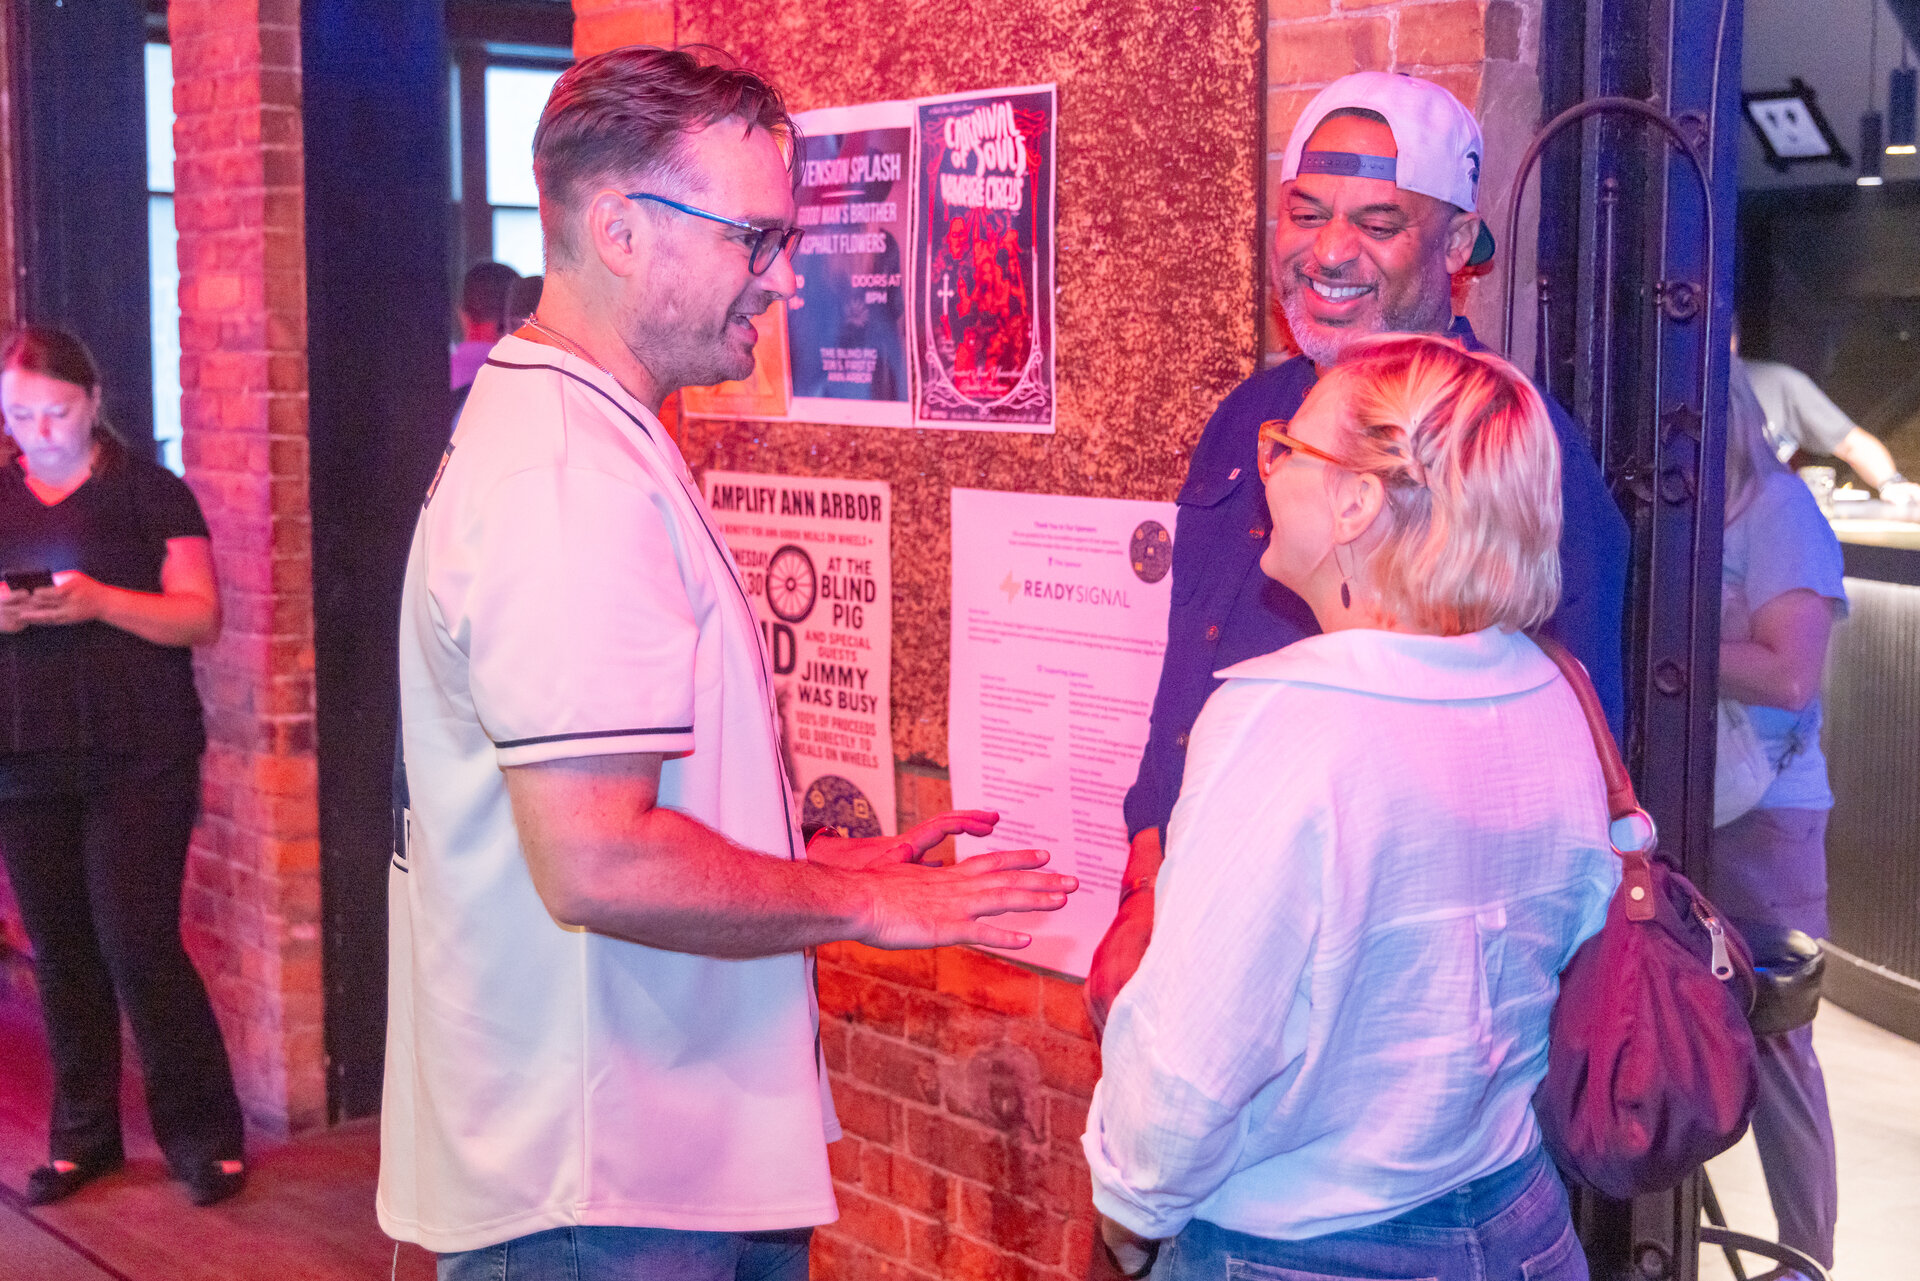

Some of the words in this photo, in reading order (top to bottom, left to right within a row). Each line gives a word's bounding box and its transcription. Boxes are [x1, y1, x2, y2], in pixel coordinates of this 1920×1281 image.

[944, 100, 1020, 150] CARNIVAL
[851, 153, 901, 184] SPLASH
[976, 135, 1027, 179] SOULS
[941, 172, 985, 209] VAMPIRE
[986, 176, 1024, 211] CIRCUS
[850, 201, 897, 223] BROTHER
[841, 232, 887, 254] FLOWERS
[851, 273, 887, 288] DOORS
[888, 273, 902, 287] AT
[711, 484, 777, 514] AMPLIFY
[780, 488, 816, 518] ANN
[820, 491, 882, 523] ARBOR
[730, 548, 768, 567] NESDAY
[827, 556, 841, 572] AT
[847, 558, 871, 575] THE
[821, 574, 876, 603] BLIND
[832, 603, 863, 629] PIG
[804, 630, 826, 644] AND
[829, 632, 872, 650] SPECIAL
[817, 645, 858, 663] GUESTS
[801, 661, 869, 690] JIMMY
[798, 684, 833, 708] WAS
[838, 690, 878, 715] BUSY
[832, 715, 877, 737] PROCEEDS
[814, 729, 855, 749] DIRECTLY
[859, 737, 872, 752] TO
[794, 742, 823, 758] MEALS
[825, 747, 838, 761] ON
[841, 750, 879, 769] WHEELS
